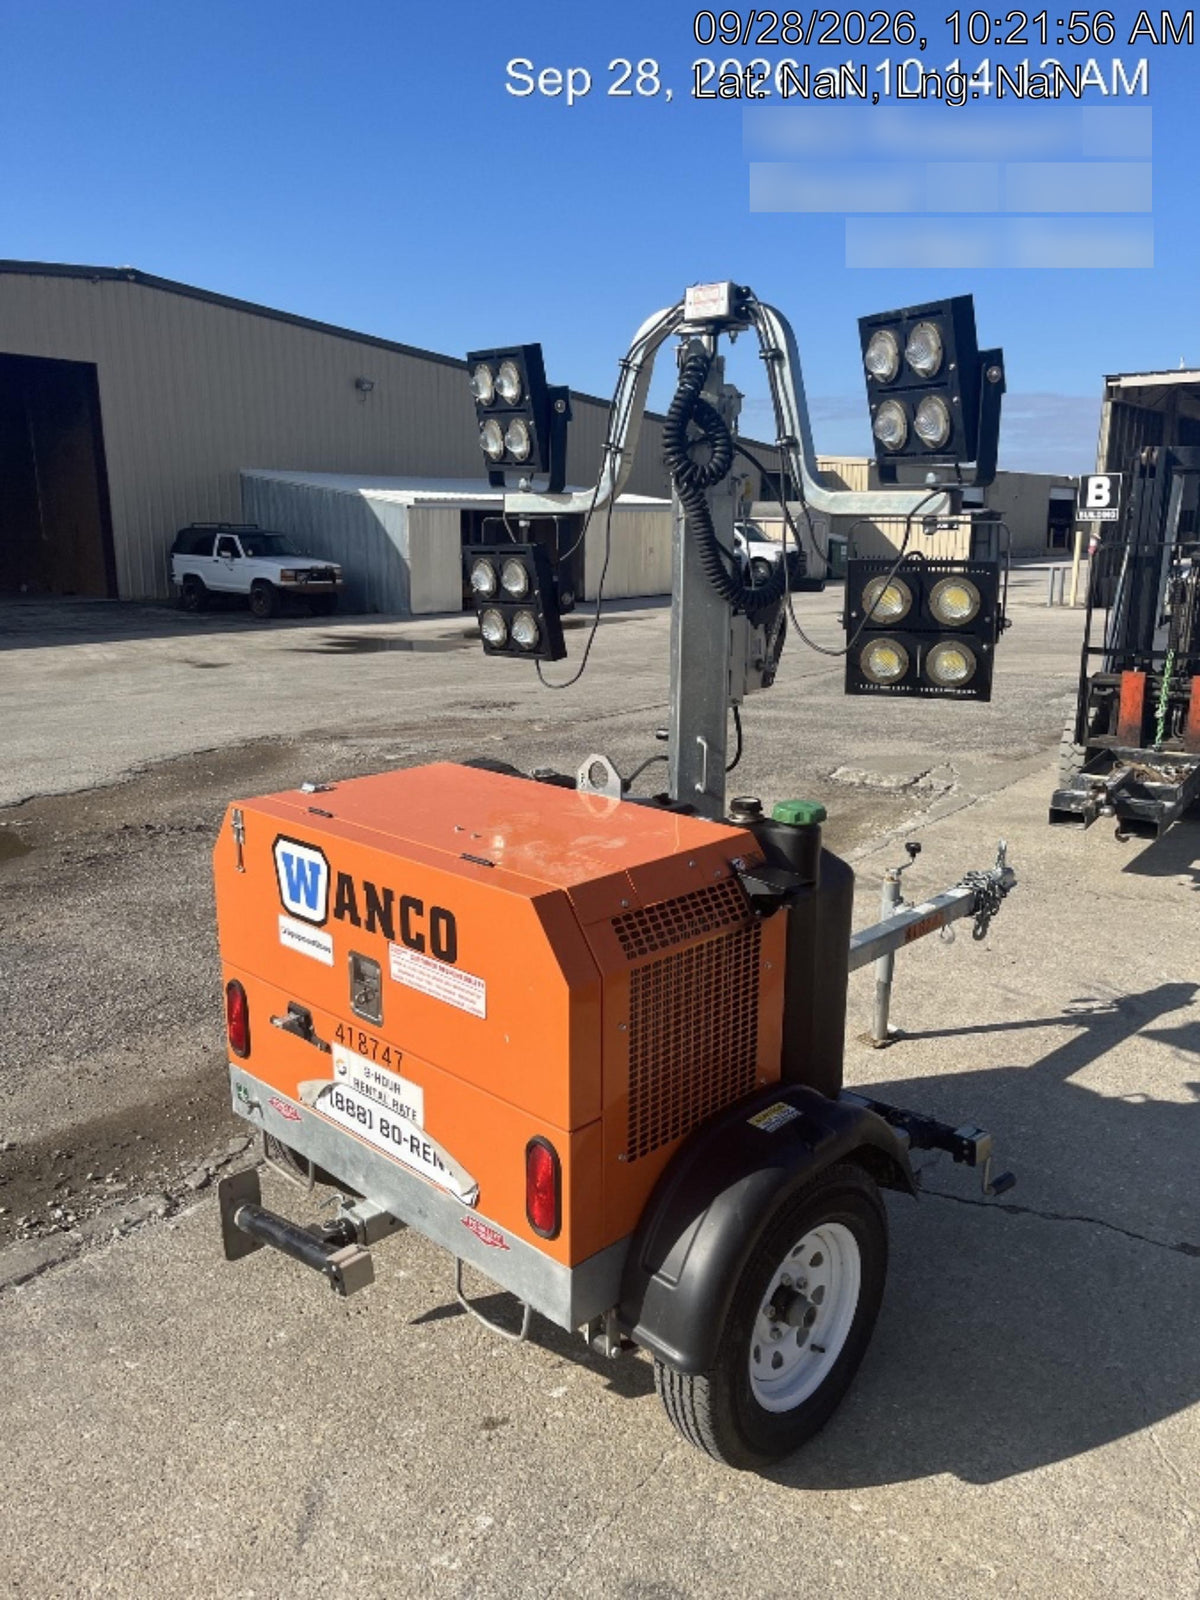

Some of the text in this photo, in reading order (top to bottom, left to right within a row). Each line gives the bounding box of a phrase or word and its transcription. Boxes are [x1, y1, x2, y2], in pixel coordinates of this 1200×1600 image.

[1086, 475, 1111, 507] B
[281, 851, 458, 964] WANCO
[335, 1023, 403, 1073] 418747
[328, 1087, 373, 1130] (888)
[379, 1116, 454, 1177] 80-REN
